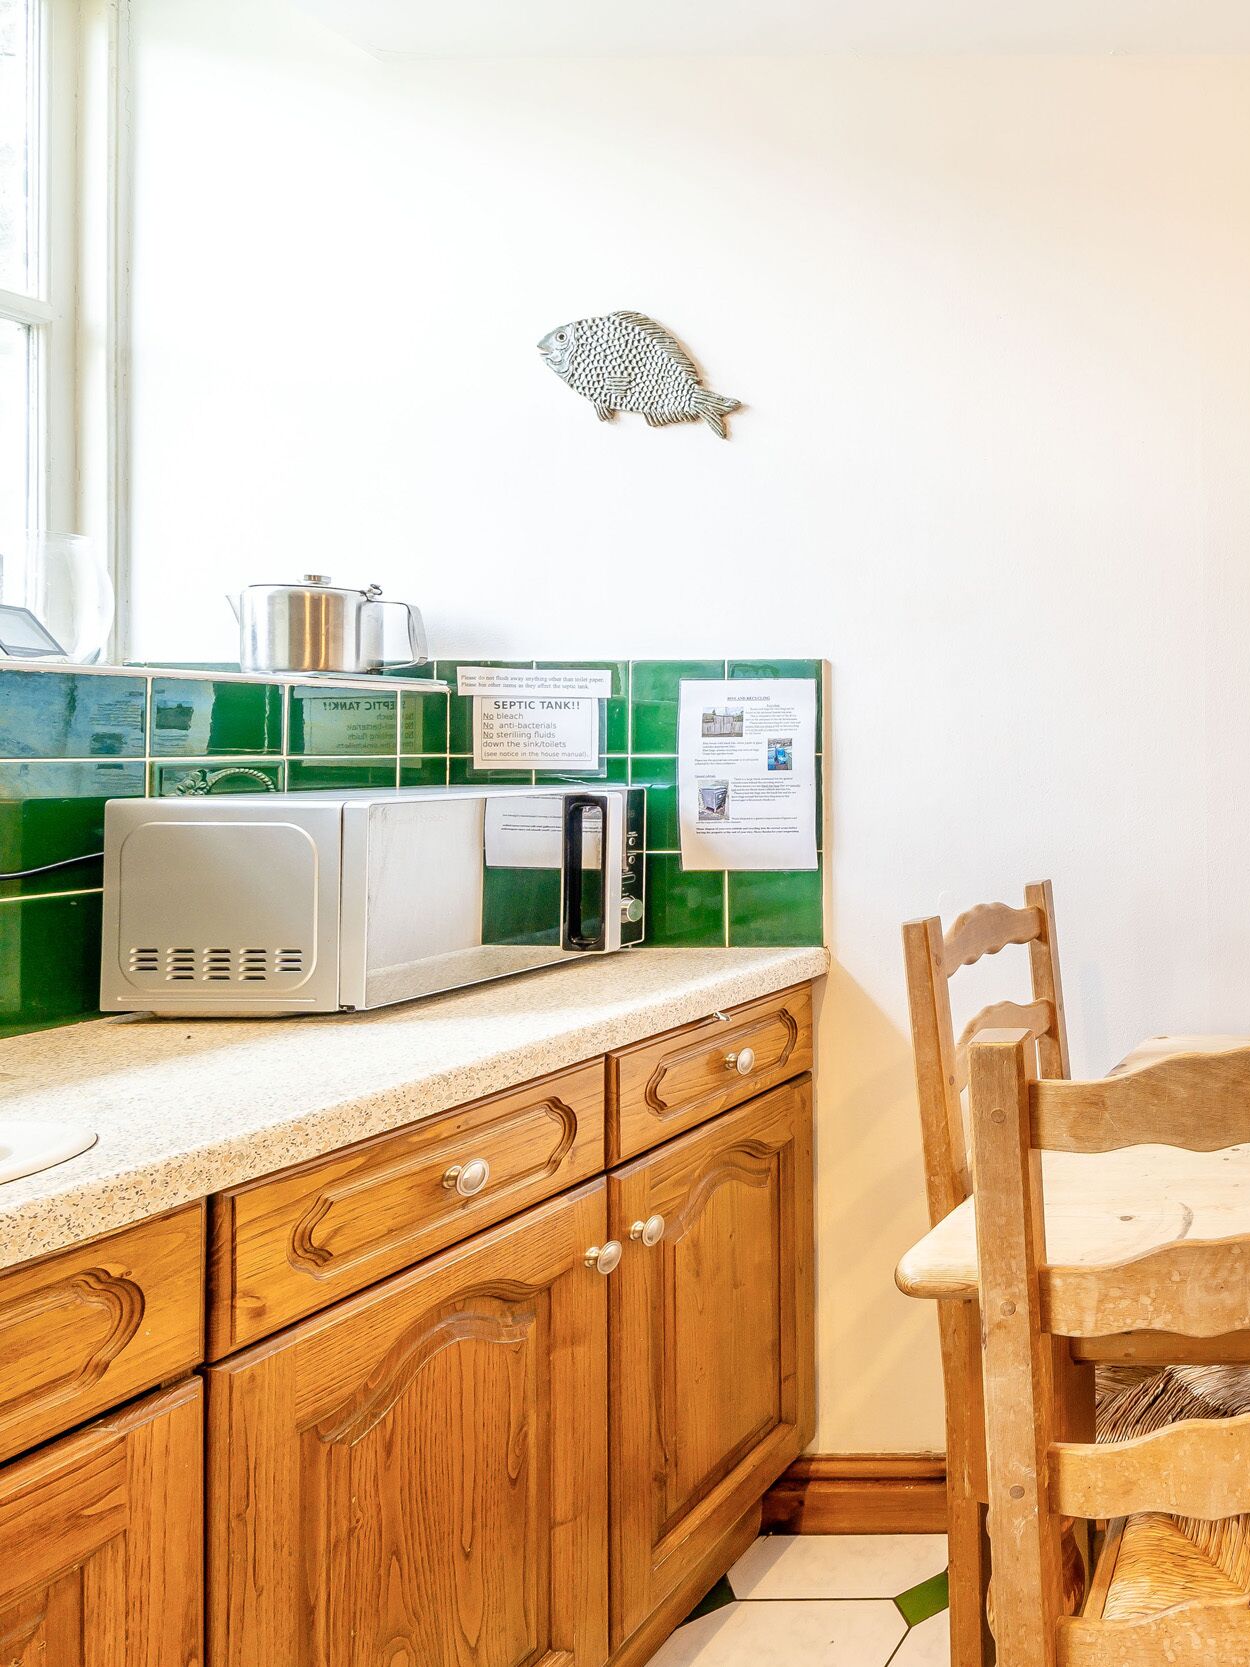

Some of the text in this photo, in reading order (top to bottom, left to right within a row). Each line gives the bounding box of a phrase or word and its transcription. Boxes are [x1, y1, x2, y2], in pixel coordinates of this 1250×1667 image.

[494, 700, 580, 710] SEPTIC TANK!!
[482, 731, 494, 739] No
[534, 731, 556, 739] fluids
[522, 740, 567, 748] sink/toilets
